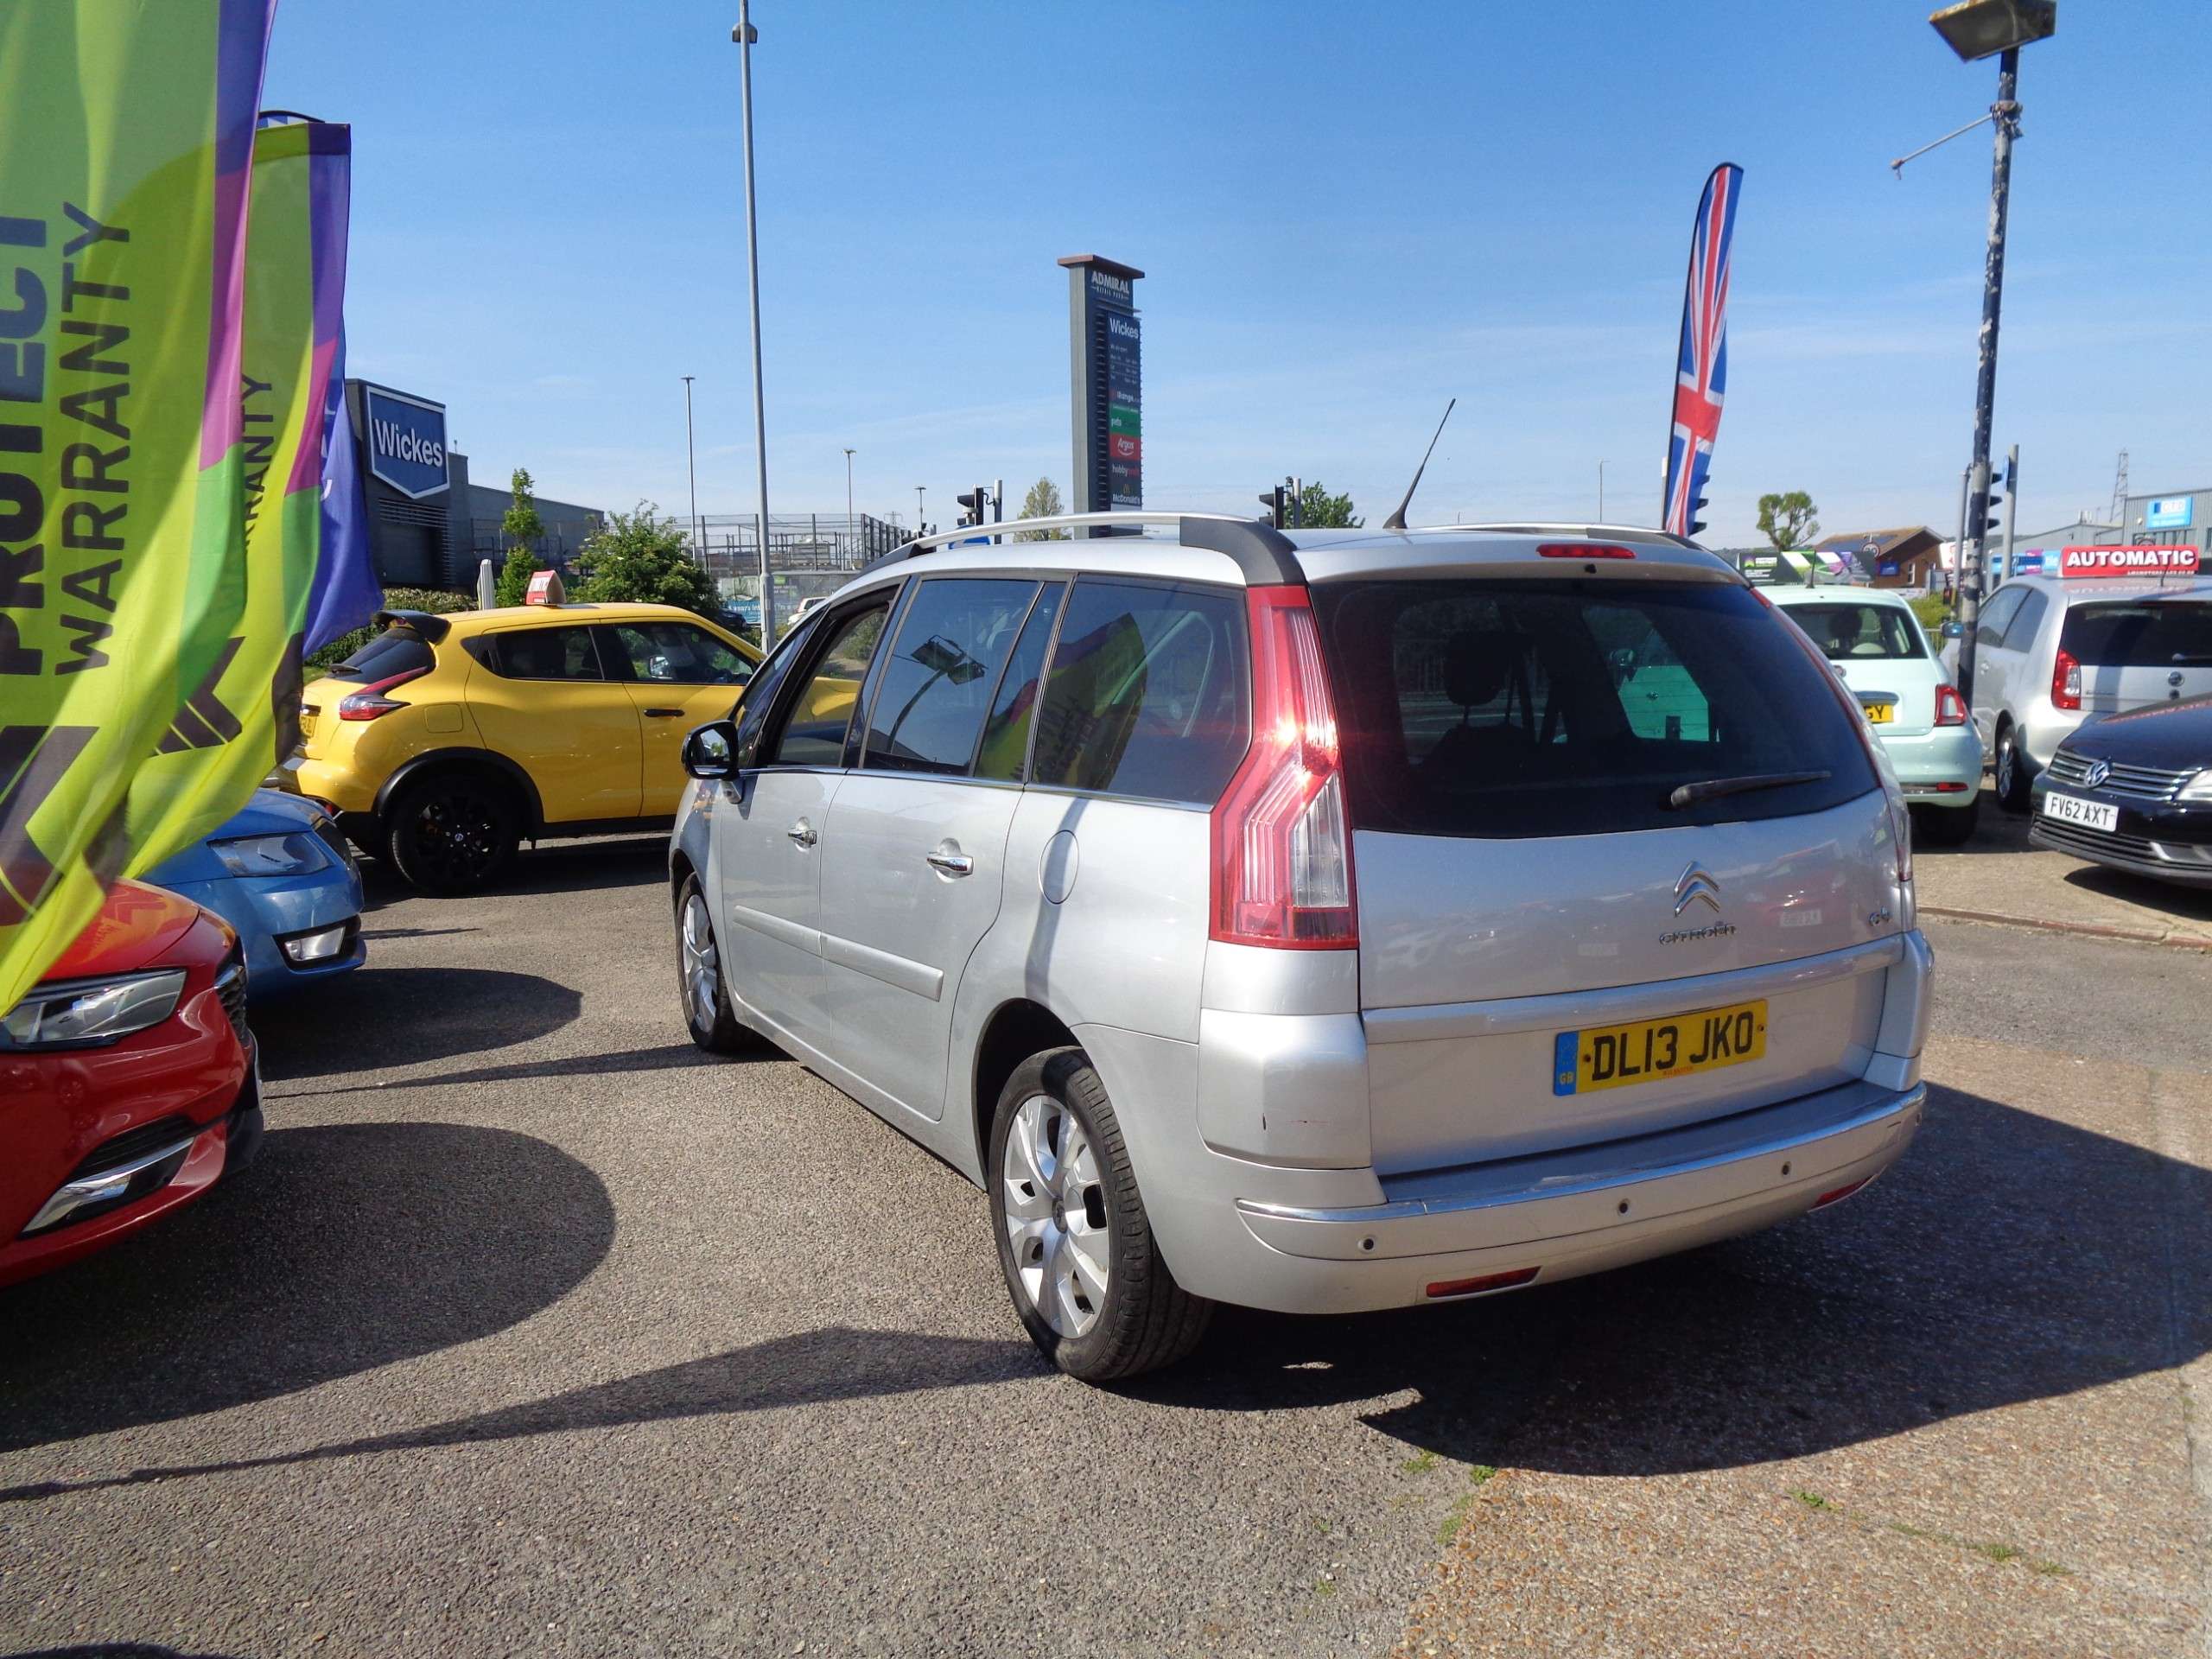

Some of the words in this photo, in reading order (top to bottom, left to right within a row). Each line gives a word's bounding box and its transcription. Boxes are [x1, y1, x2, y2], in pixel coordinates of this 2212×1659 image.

[1090, 270, 1129, 295] ADMIRAL
[1109, 317, 1139, 339] Wickes
[54, 200, 130, 677] WARRANTY
[374, 418, 443, 467] Wickes
[1117, 437, 1135, 451] Argos
[2066, 550, 2195, 568] AUTOMATIC
[2050, 797, 2081, 819] FV62
[2083, 804, 2111, 826] AXT
[1592, 1026, 1678, 1081] DL13
[1688, 1011, 1754, 1064] JKO
